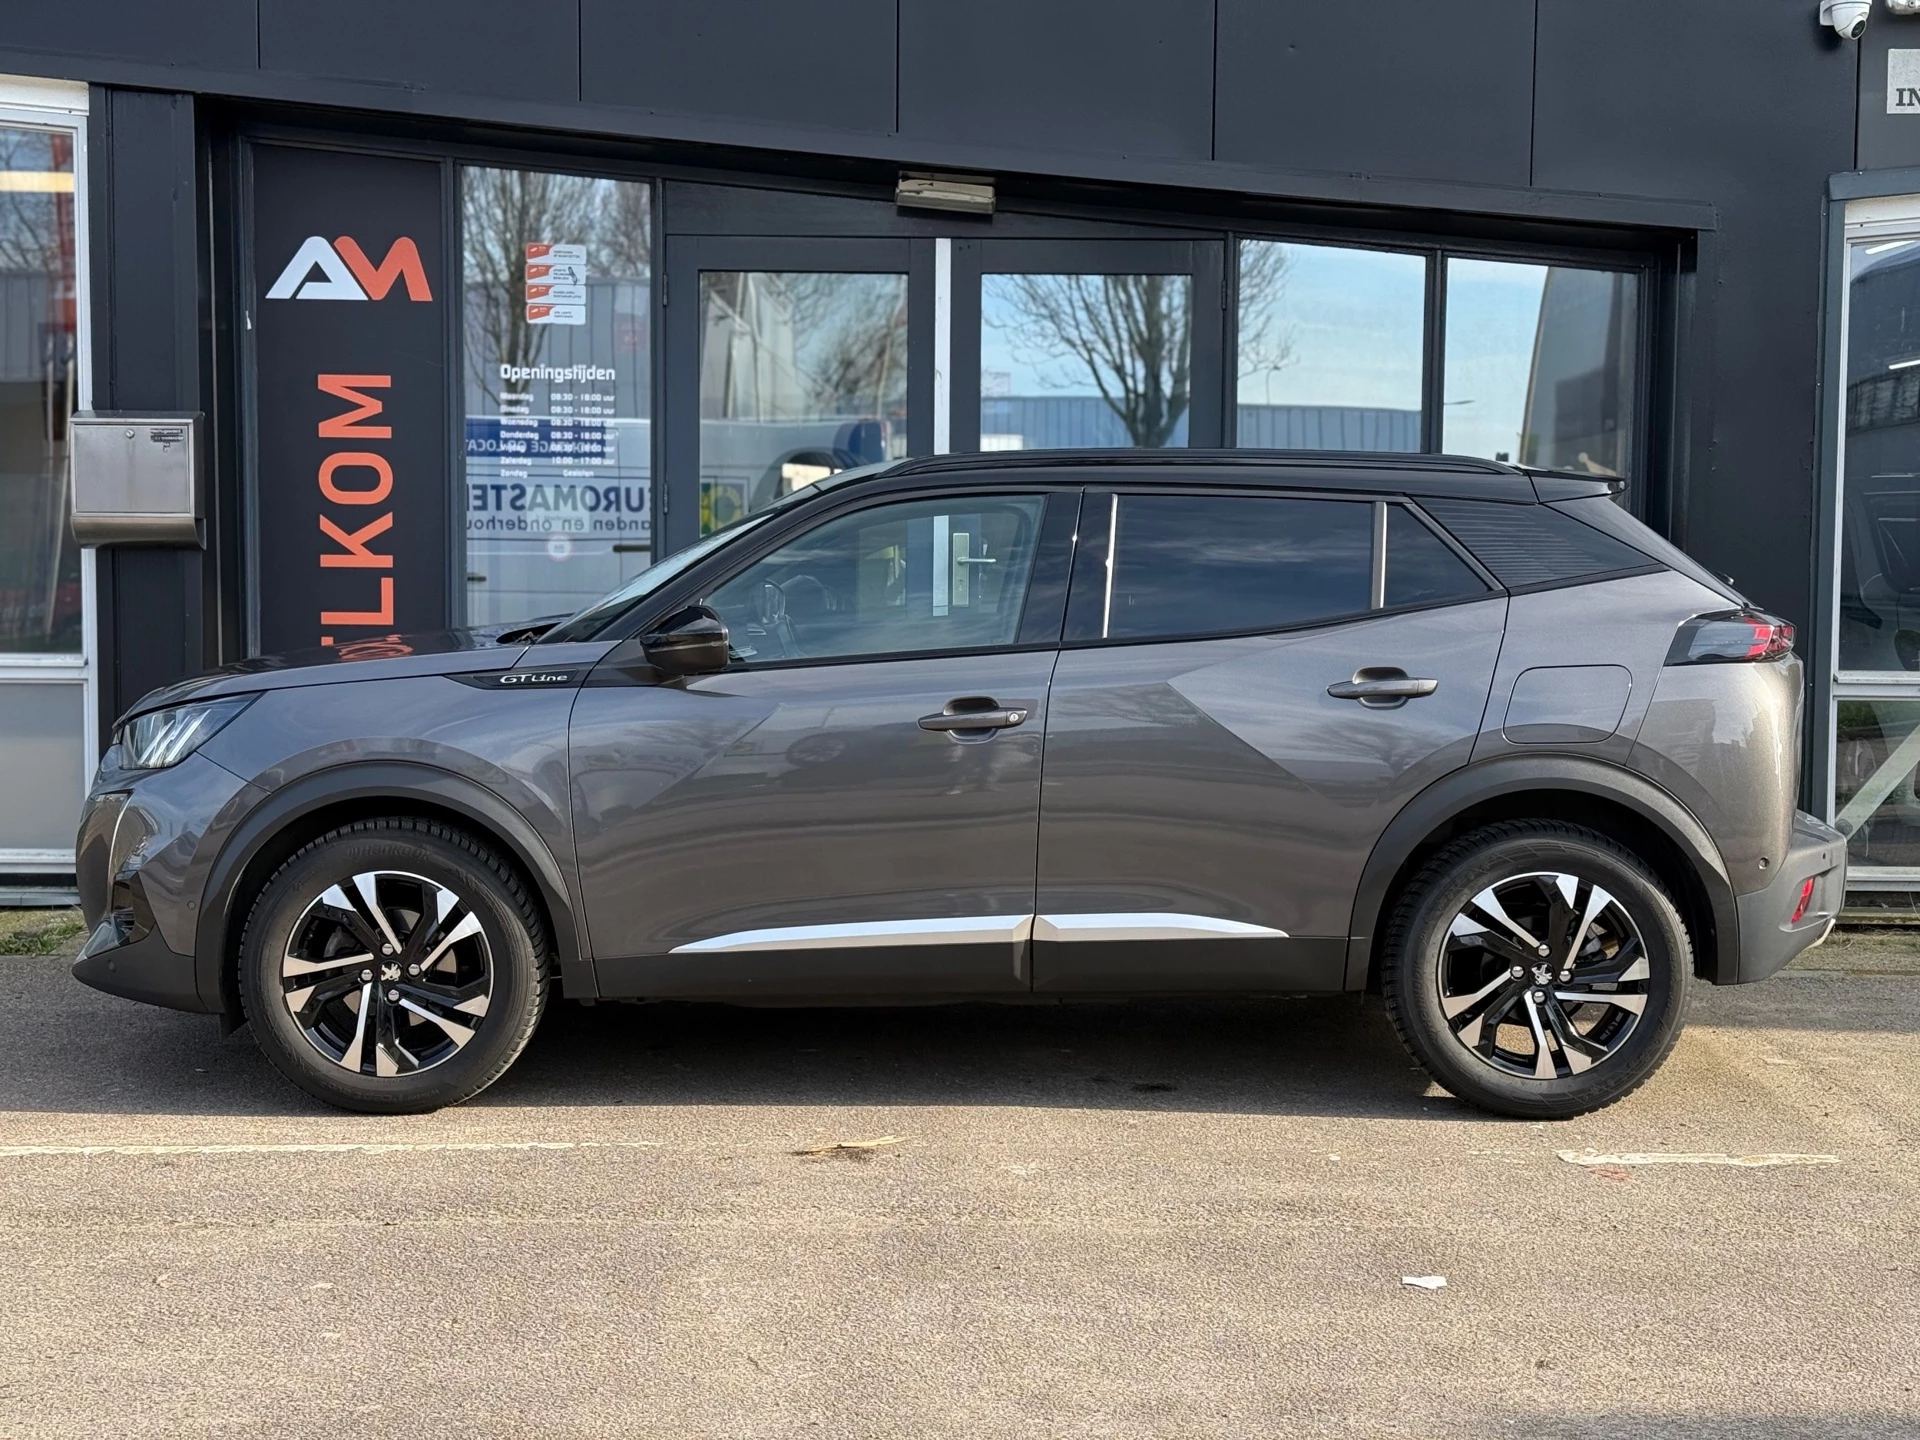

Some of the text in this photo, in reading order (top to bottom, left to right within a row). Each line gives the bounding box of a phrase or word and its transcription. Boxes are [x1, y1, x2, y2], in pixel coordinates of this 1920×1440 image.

[265, 235, 434, 302] AM
[499, 363, 616, 384] Openingstijden
[500, 392, 534, 402] Maandag
[500, 405, 529, 415] Dinsdag
[500, 418, 539, 428] Woensdag
[500, 431, 539, 440] Donderdag
[500, 456, 533, 466] Zaterdag
[500, 469, 528, 478] Zondag
[317, 374, 395, 647] LKOM
